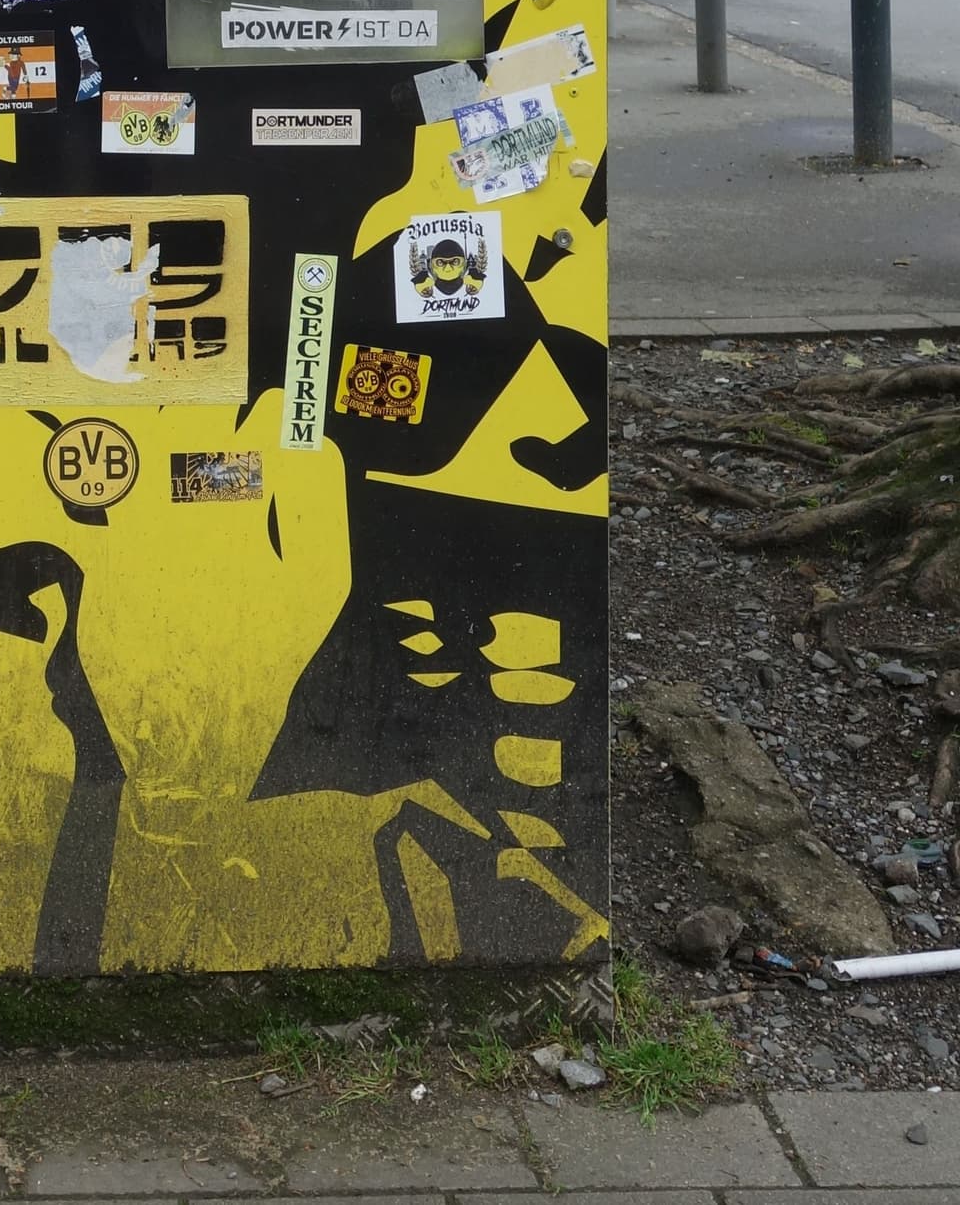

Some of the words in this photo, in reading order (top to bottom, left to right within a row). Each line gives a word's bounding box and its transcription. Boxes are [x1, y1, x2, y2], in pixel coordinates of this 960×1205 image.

[228, 19, 334, 41] POWER
[356, 19, 388, 39] IST
[398, 19, 430, 38] DA
[33, 65, 48, 78] 12
[13, 101, 34, 110] TOUR
[123, 114, 149, 138] BVB
[256, 114, 353, 128] DORTMUNDER
[490, 118, 558, 162] DORTMUND
[408, 214, 484, 241] Borussia
[420, 297, 481, 316] DORTMUND
[289, 295, 325, 444] SECTREM
[356, 370, 379, 388] BVB
[58, 430, 130, 482] BVB
[80, 481, 105, 498] 09
